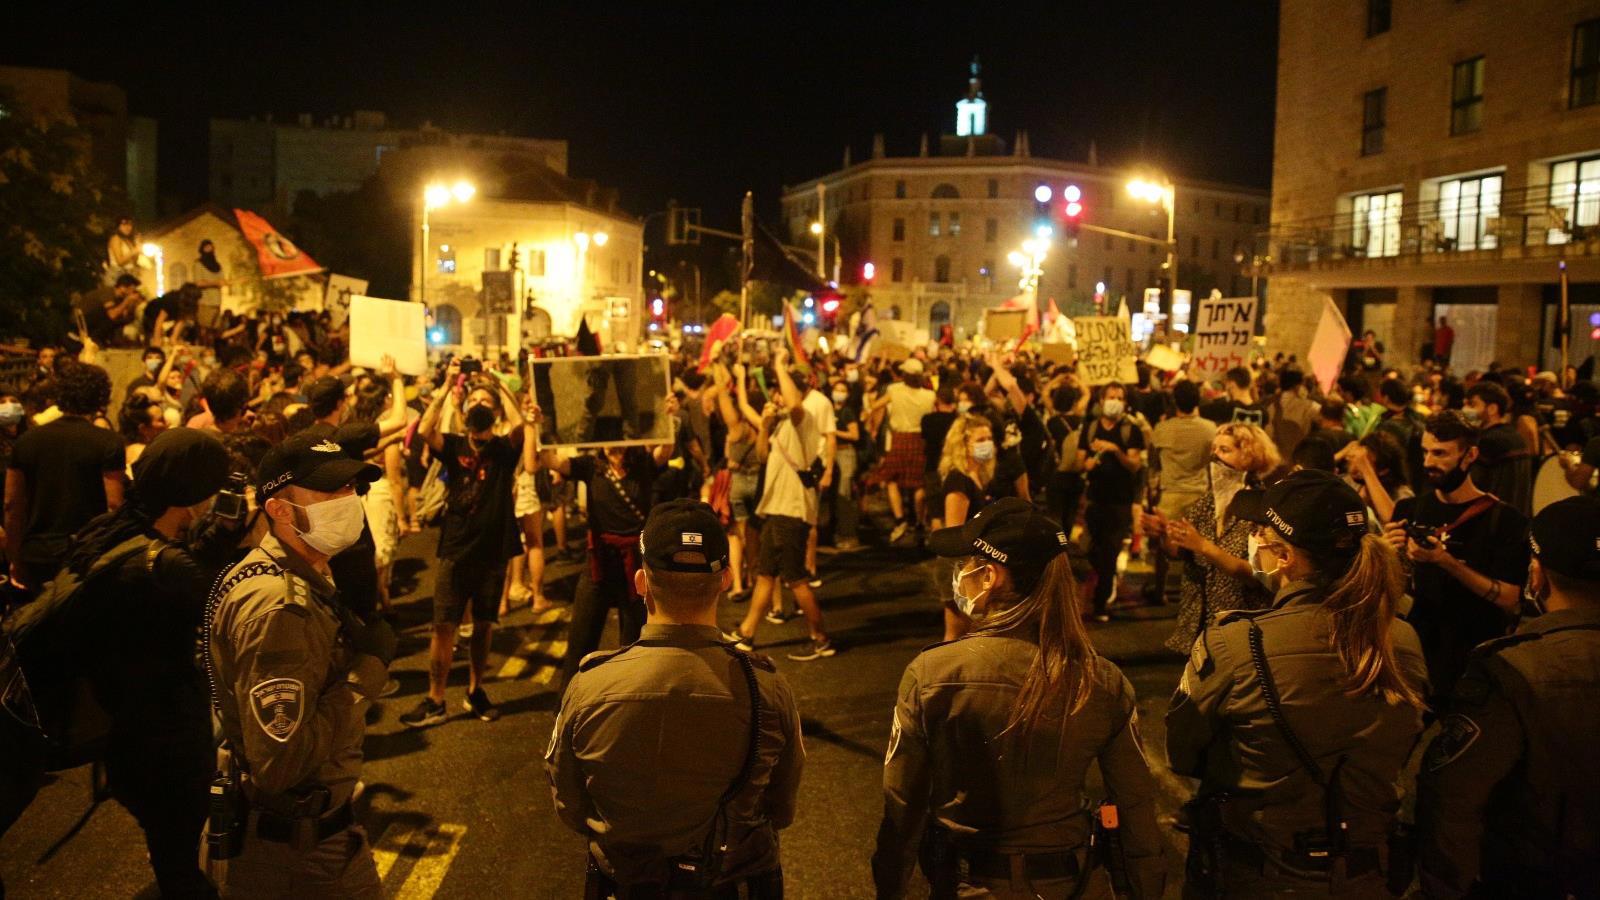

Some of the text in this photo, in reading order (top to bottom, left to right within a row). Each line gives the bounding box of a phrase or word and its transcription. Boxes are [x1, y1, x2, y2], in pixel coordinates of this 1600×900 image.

[1204, 302, 1252, 327] איתך
[1198, 326, 1249, 349] כל הדרך
[1196, 351, 1243, 372] לכלא
[262, 471, 294, 494] POLICE
[1265, 507, 1294, 536] משטרה
[973, 537, 1008, 563] משטרה
